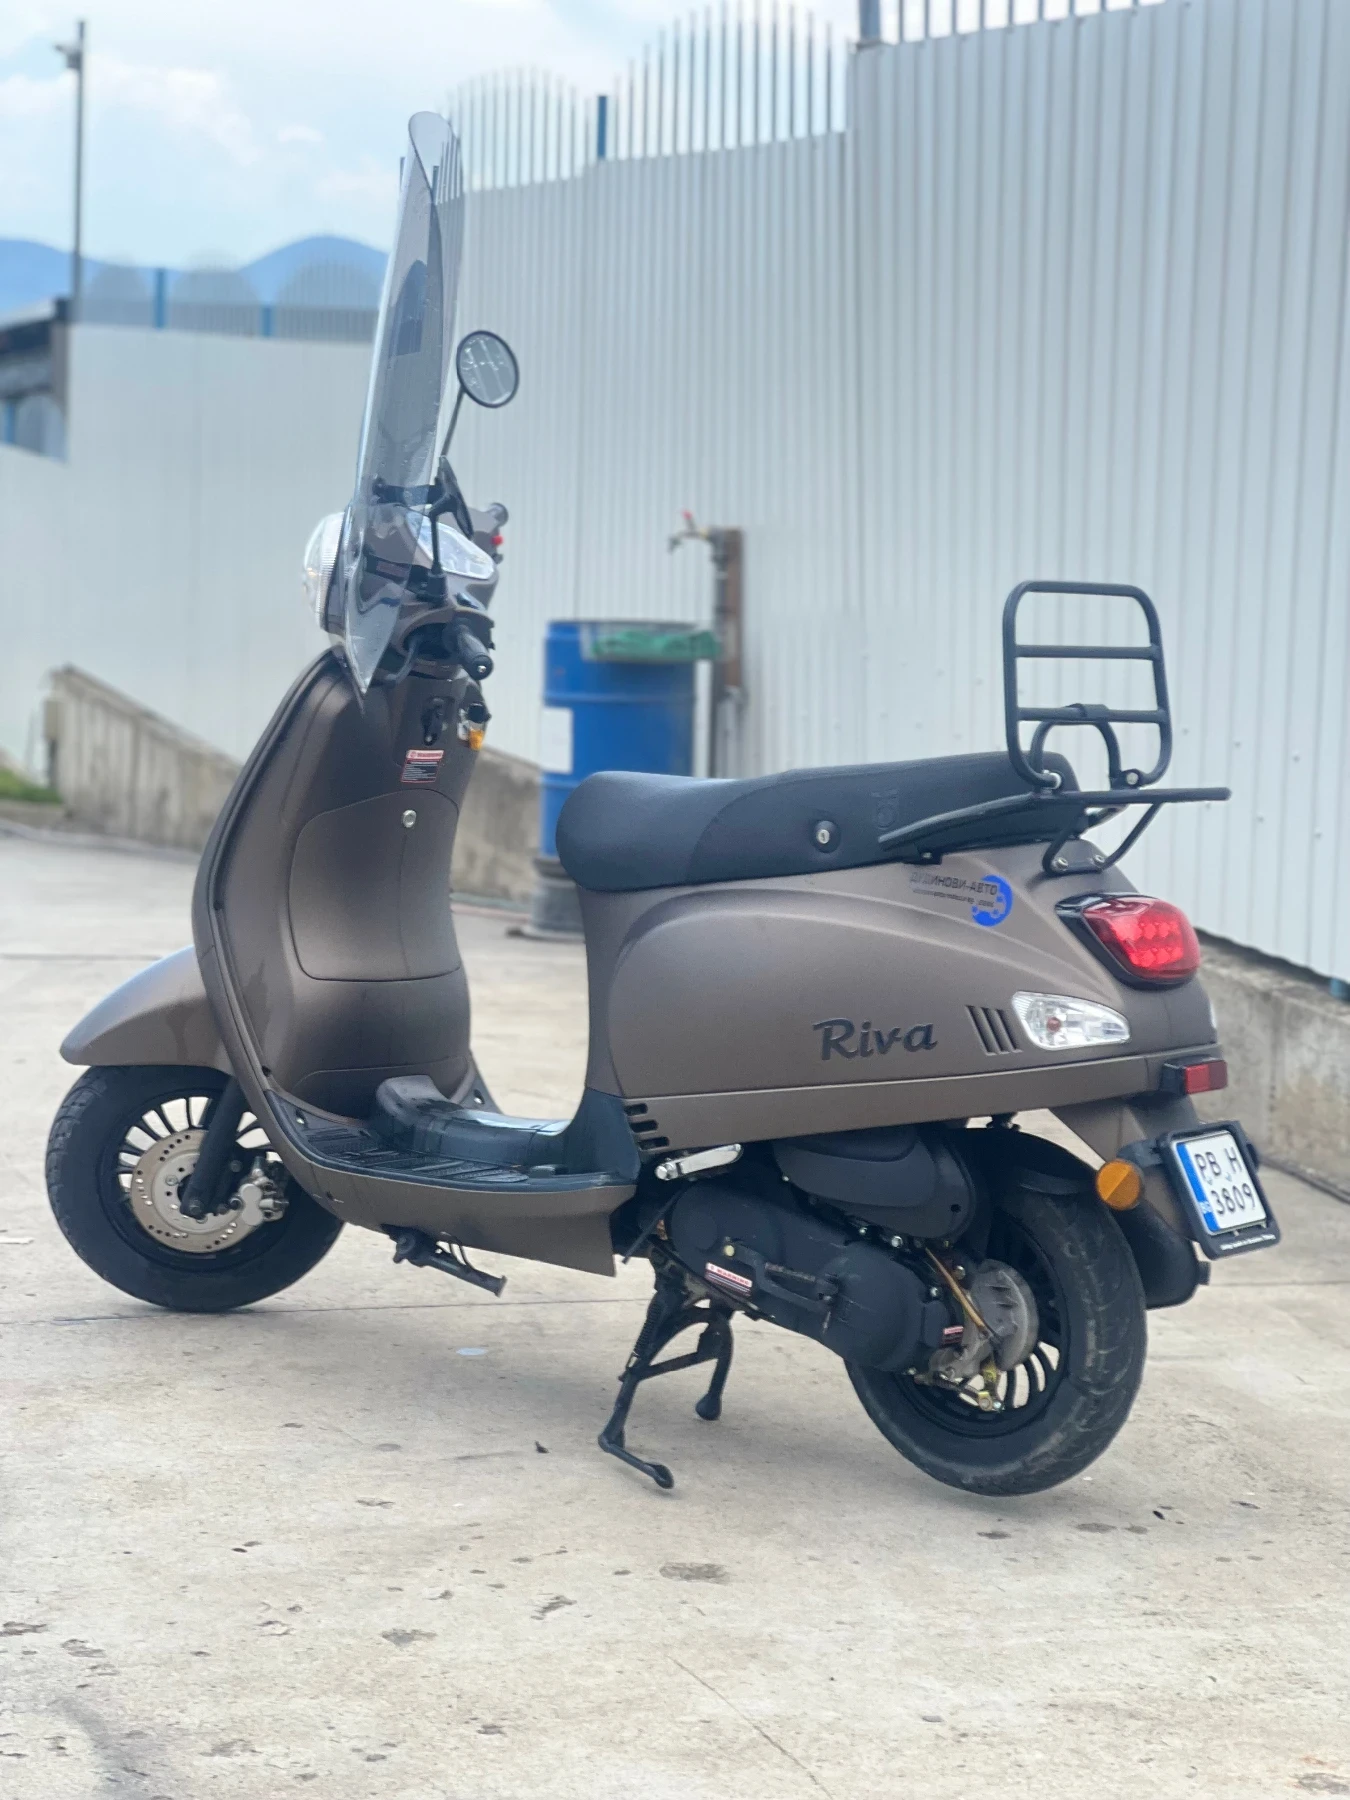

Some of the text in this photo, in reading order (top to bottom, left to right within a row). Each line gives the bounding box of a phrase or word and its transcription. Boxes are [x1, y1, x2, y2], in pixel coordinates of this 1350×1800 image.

[812, 1017, 938, 1061] Riva
[1194, 1146, 1243, 1181] PB H
[1211, 1182, 1256, 1215] 3809
